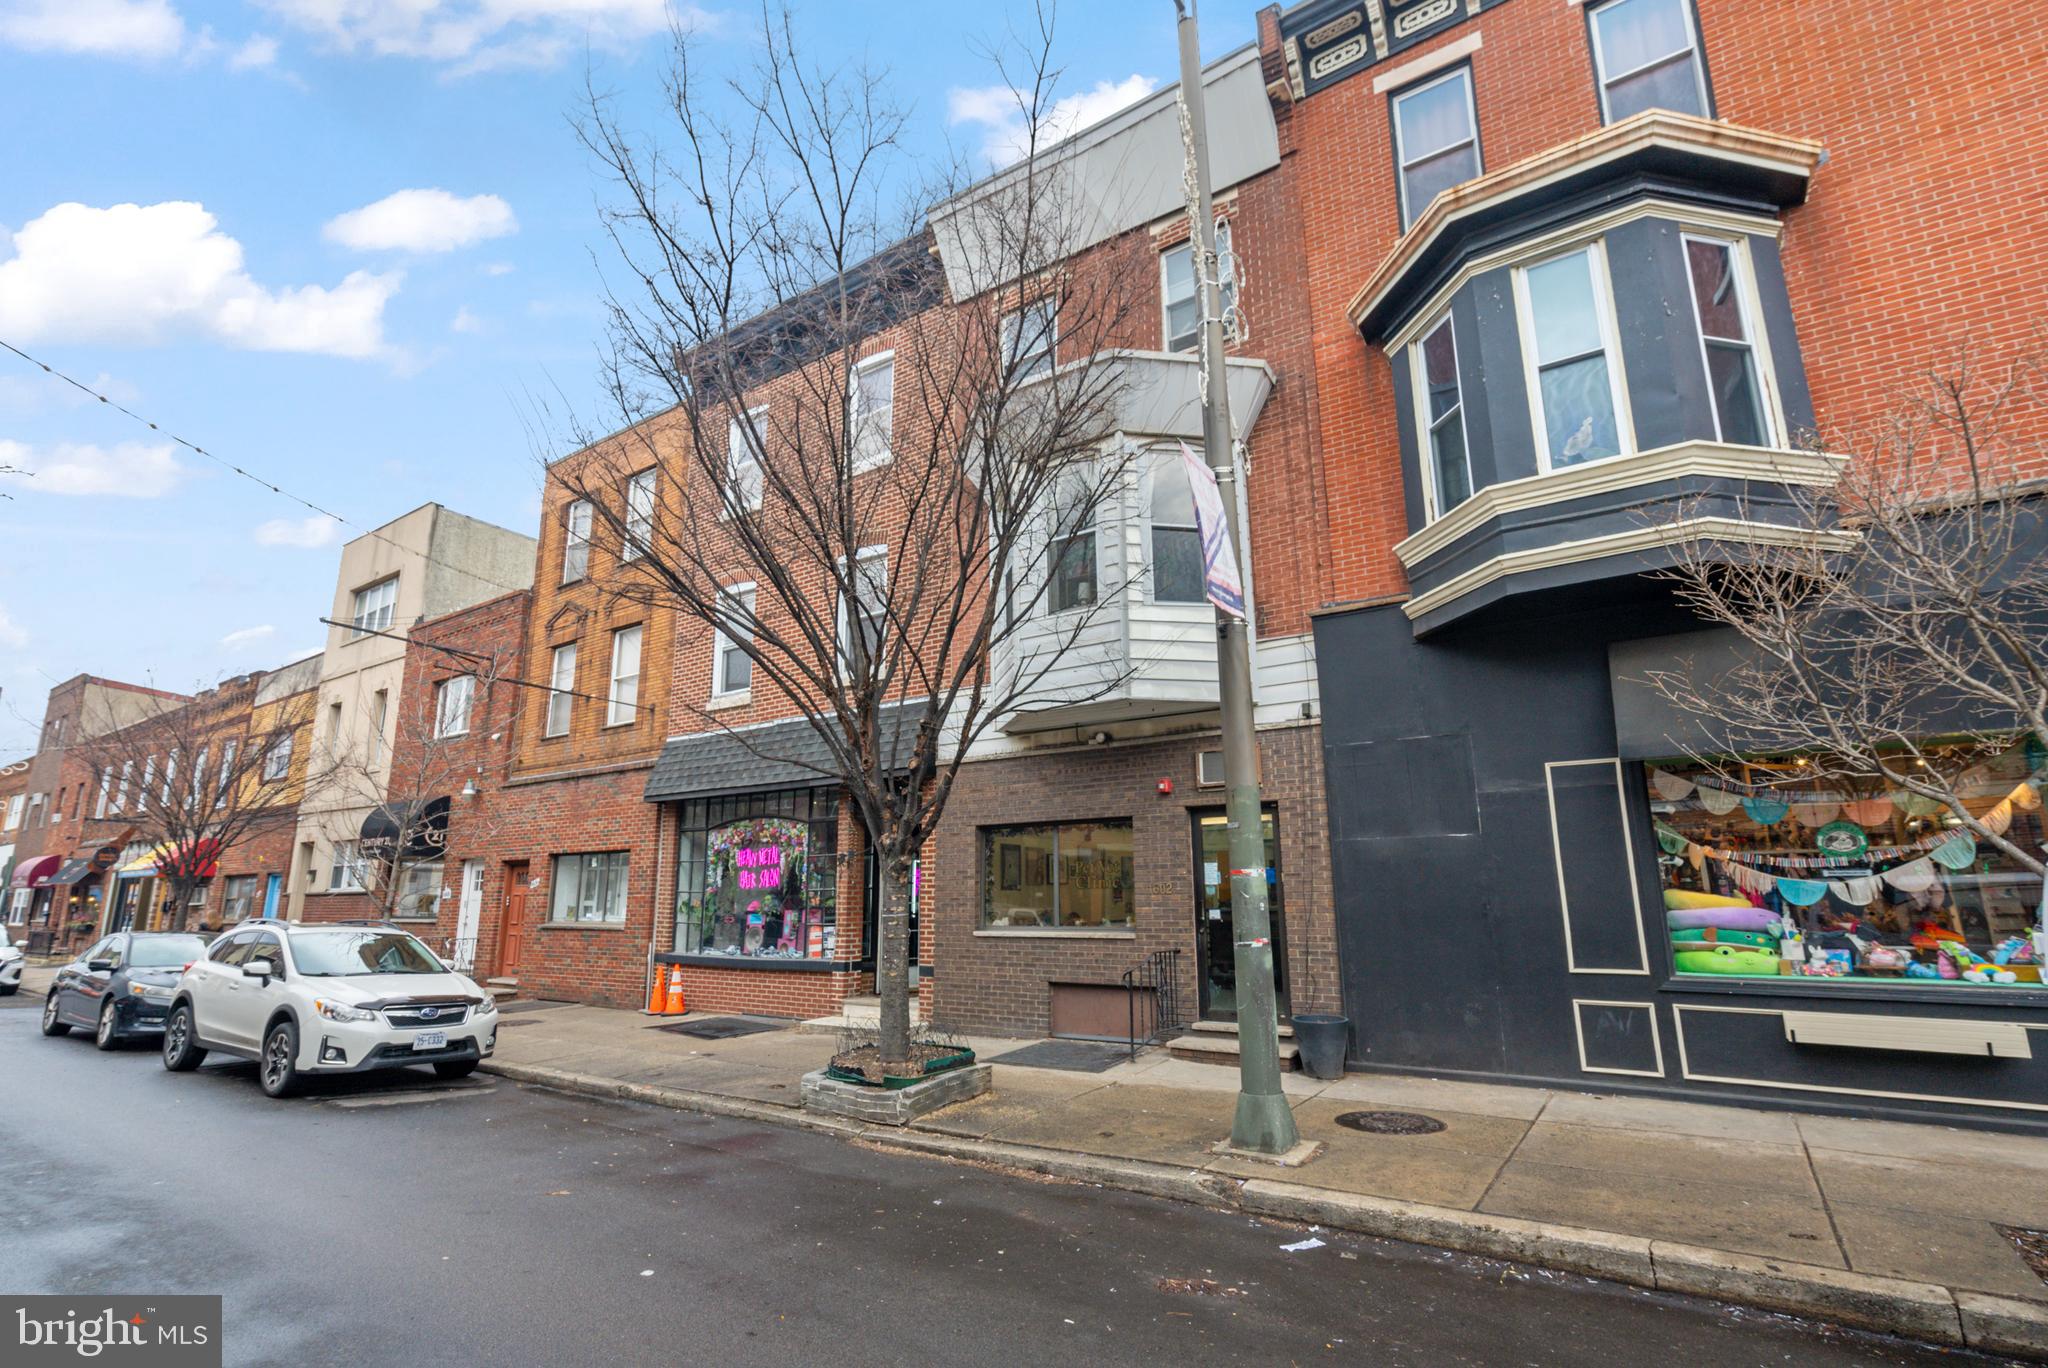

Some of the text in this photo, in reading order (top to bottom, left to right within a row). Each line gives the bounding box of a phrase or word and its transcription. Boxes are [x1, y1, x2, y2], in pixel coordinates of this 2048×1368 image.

[737, 845, 780, 868] HEAVY METAL
[739, 867, 780, 889] HAIR SALON
[1152, 882, 1173, 895] 602
